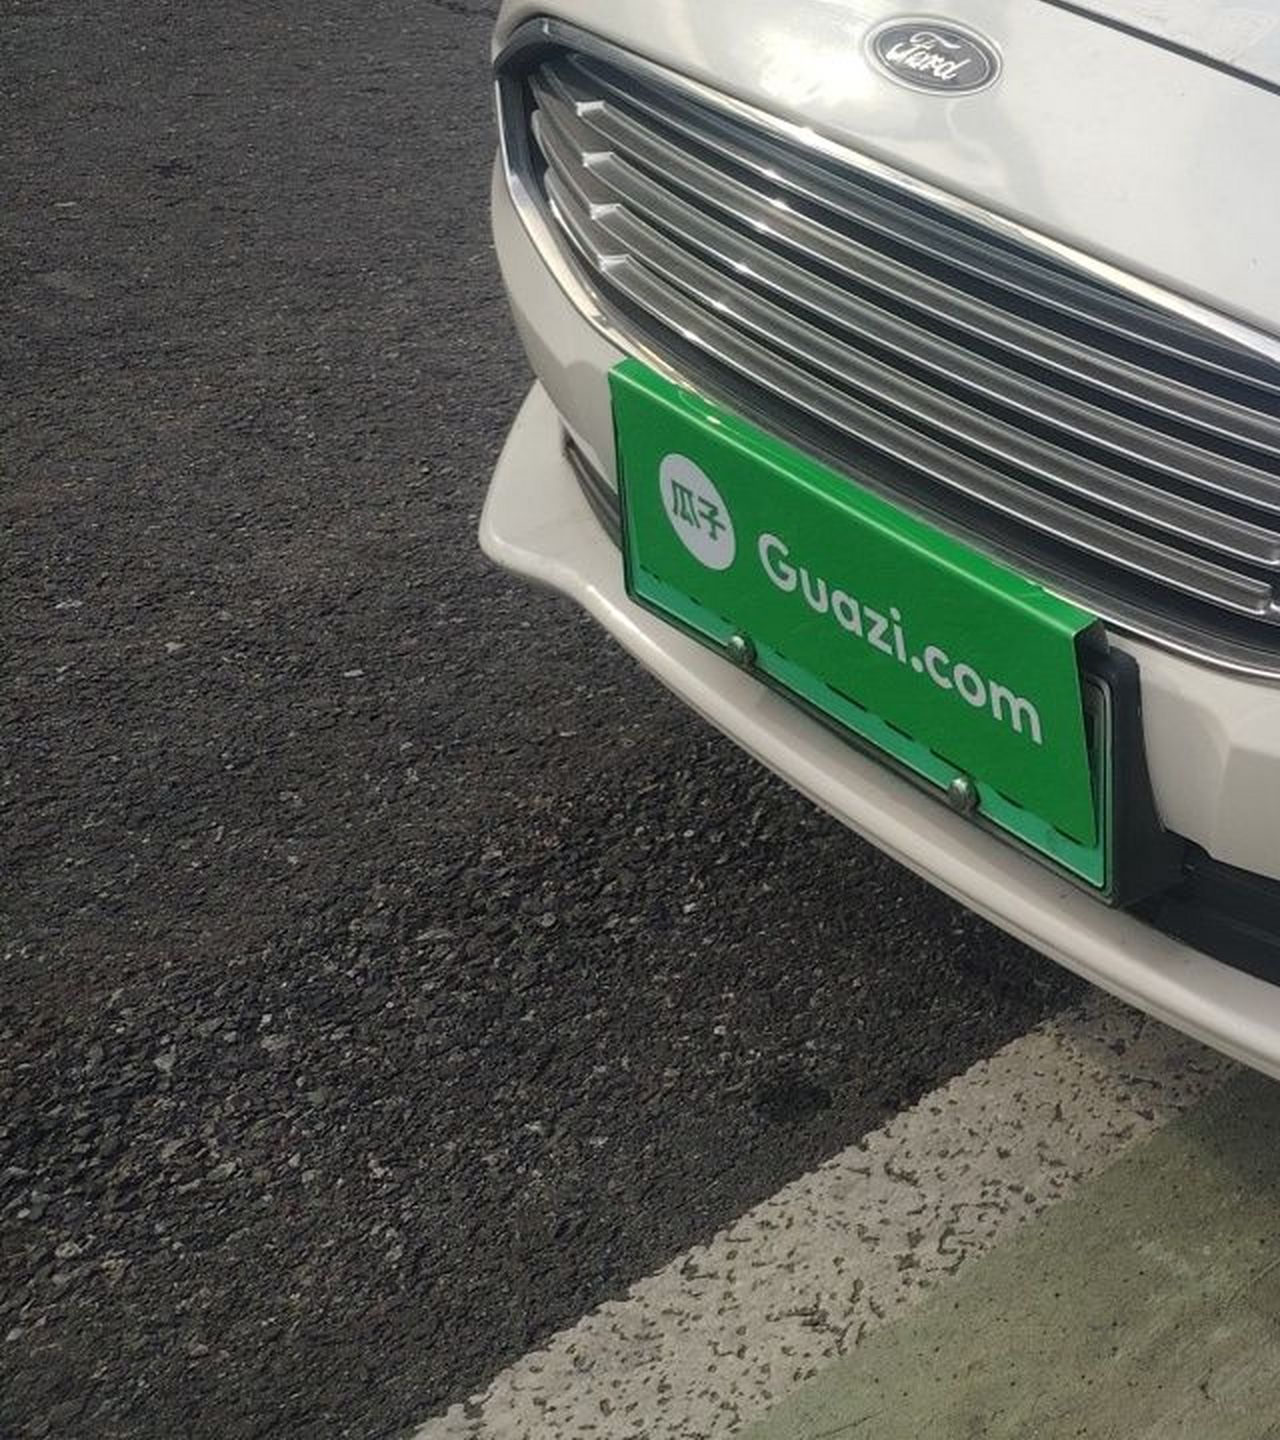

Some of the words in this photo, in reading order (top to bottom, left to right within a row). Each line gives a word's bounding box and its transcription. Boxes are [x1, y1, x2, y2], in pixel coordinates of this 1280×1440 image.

[885, 31, 971, 80] Ford
[670, 479, 726, 542] 瓜子
[757, 533, 1043, 745] Guazi.com
